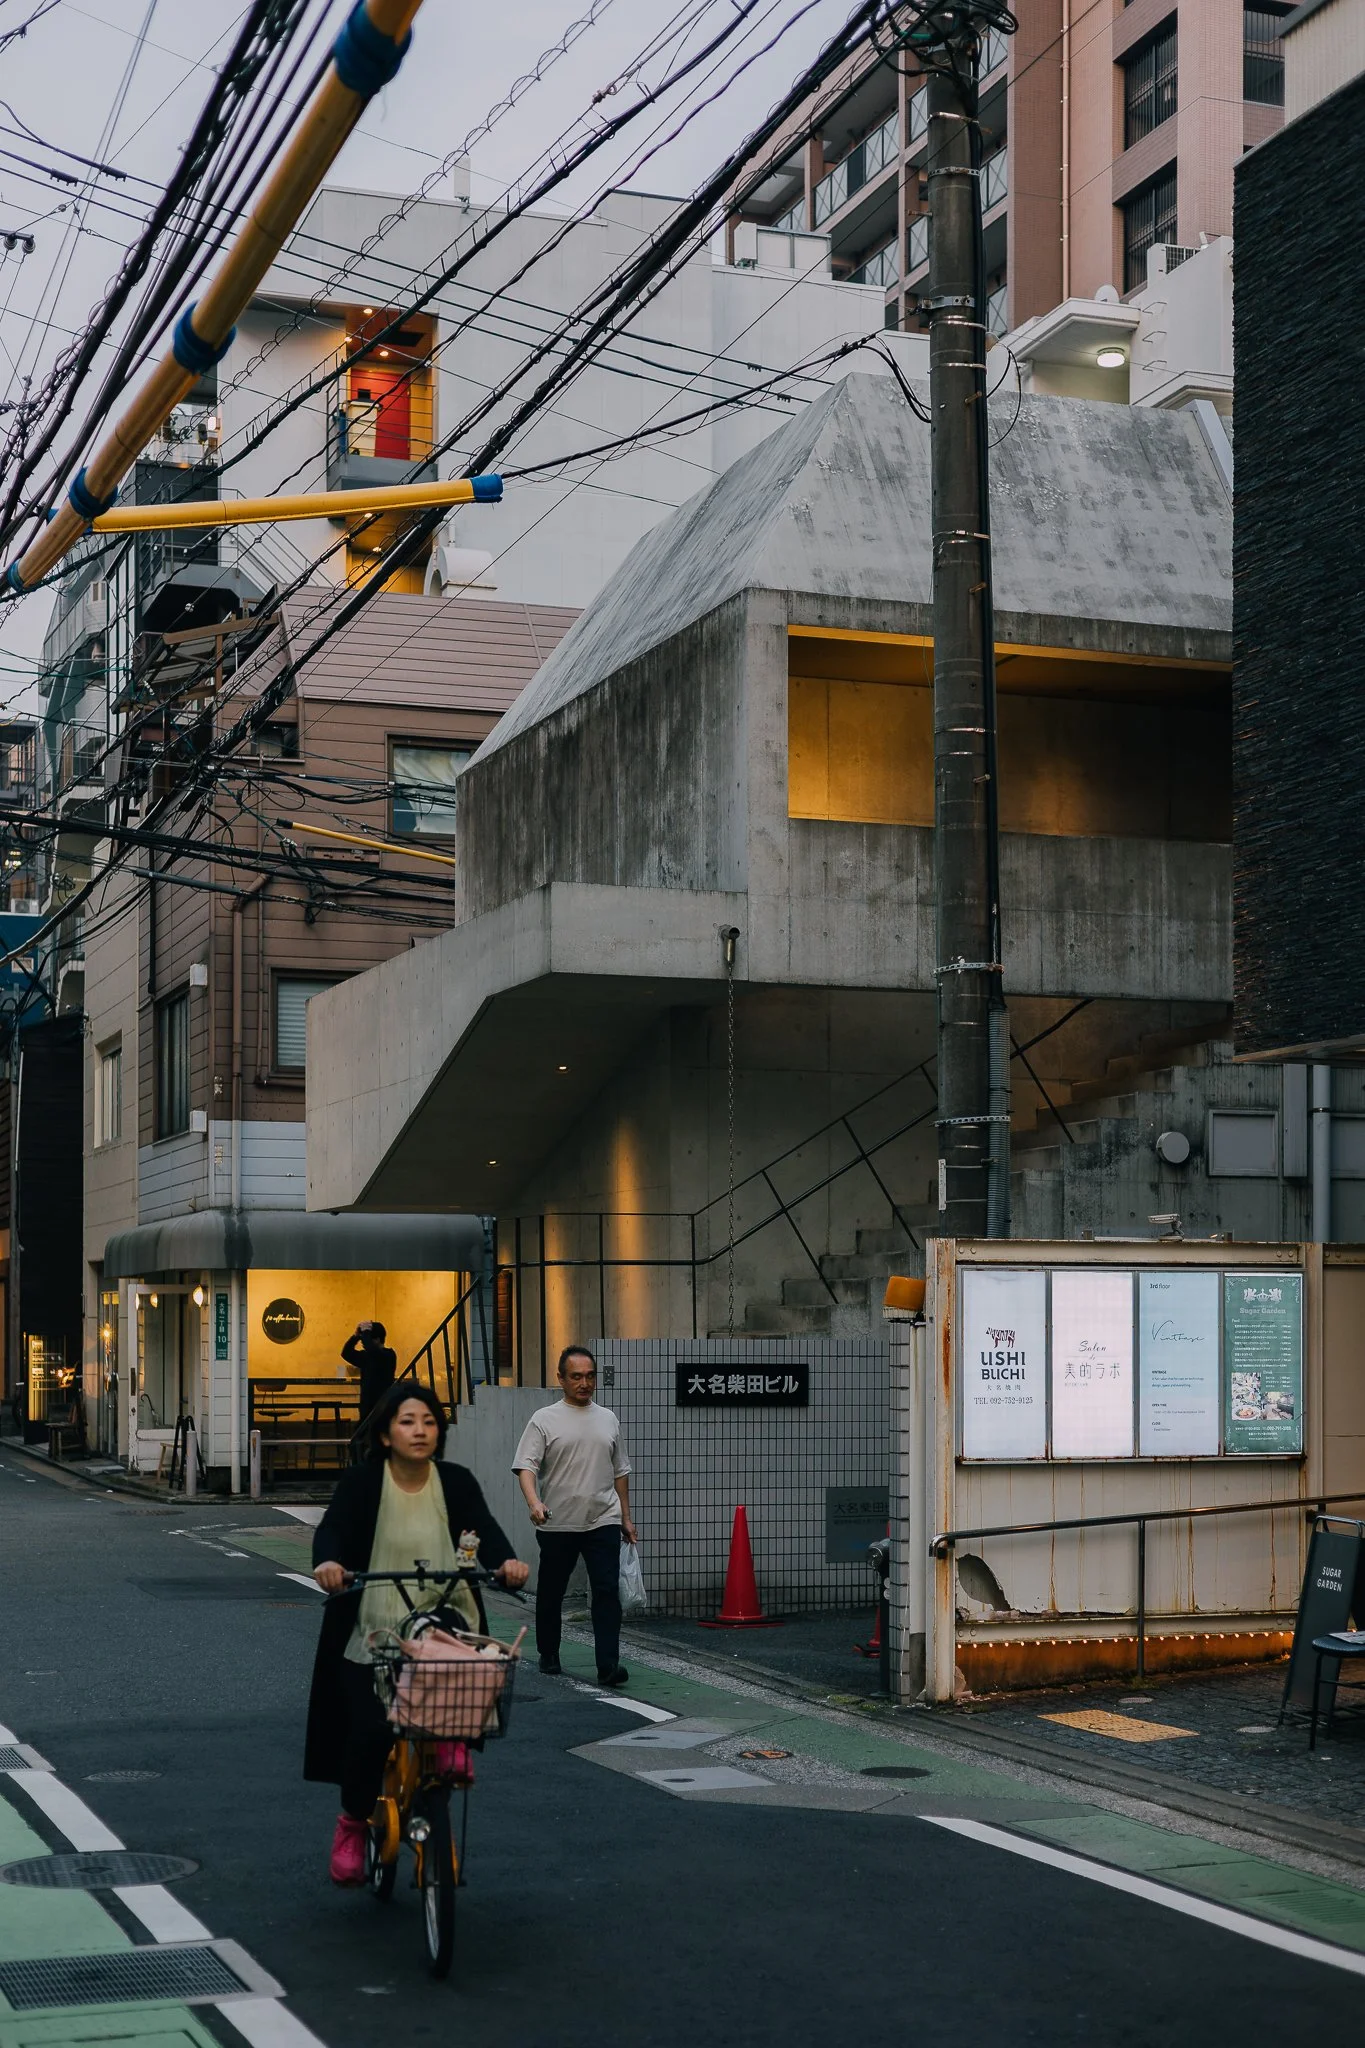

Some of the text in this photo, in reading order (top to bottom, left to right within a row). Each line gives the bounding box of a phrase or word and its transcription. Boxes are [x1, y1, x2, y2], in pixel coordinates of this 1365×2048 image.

[217, 1335, 227, 1343] 10
[980, 1351, 1026, 1366] USHI
[981, 1368, 1026, 1380] BUCHI
[1064, 1362, 1120, 1380] 美的ラボ
[687, 1374, 799, 1394] 大名柴田ビル
[973, 1397, 988, 1405] TEL
[1322, 1566, 1342, 1578] SUGAR
[1317, 1578, 1343, 1592] GARDEN
